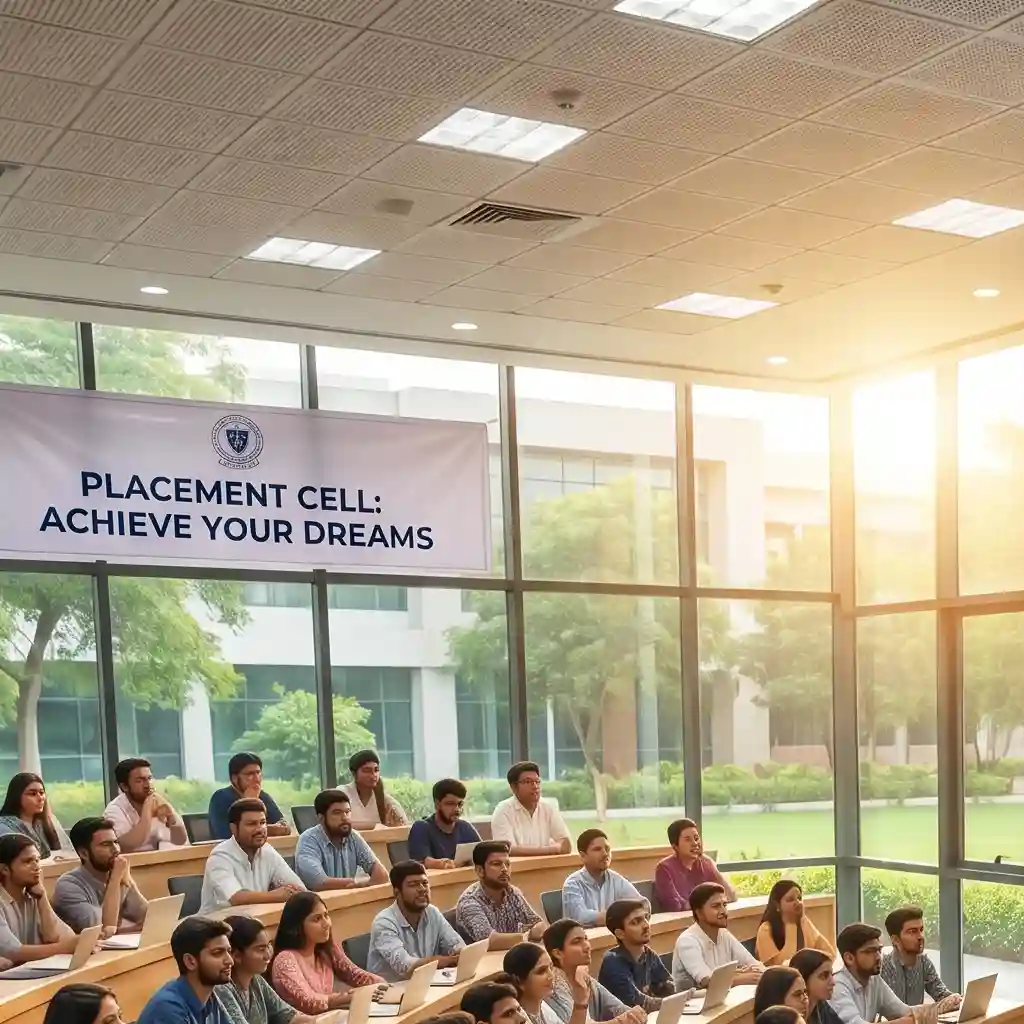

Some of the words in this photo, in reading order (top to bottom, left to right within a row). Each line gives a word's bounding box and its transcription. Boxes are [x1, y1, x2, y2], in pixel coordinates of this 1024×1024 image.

[80, 470, 288, 509] PLACEMENT
[297, 485, 382, 515] CELL:
[39, 506, 193, 539] ACHIEVE
[200, 515, 294, 544] YOUR
[303, 520, 434, 550] DREAMS
